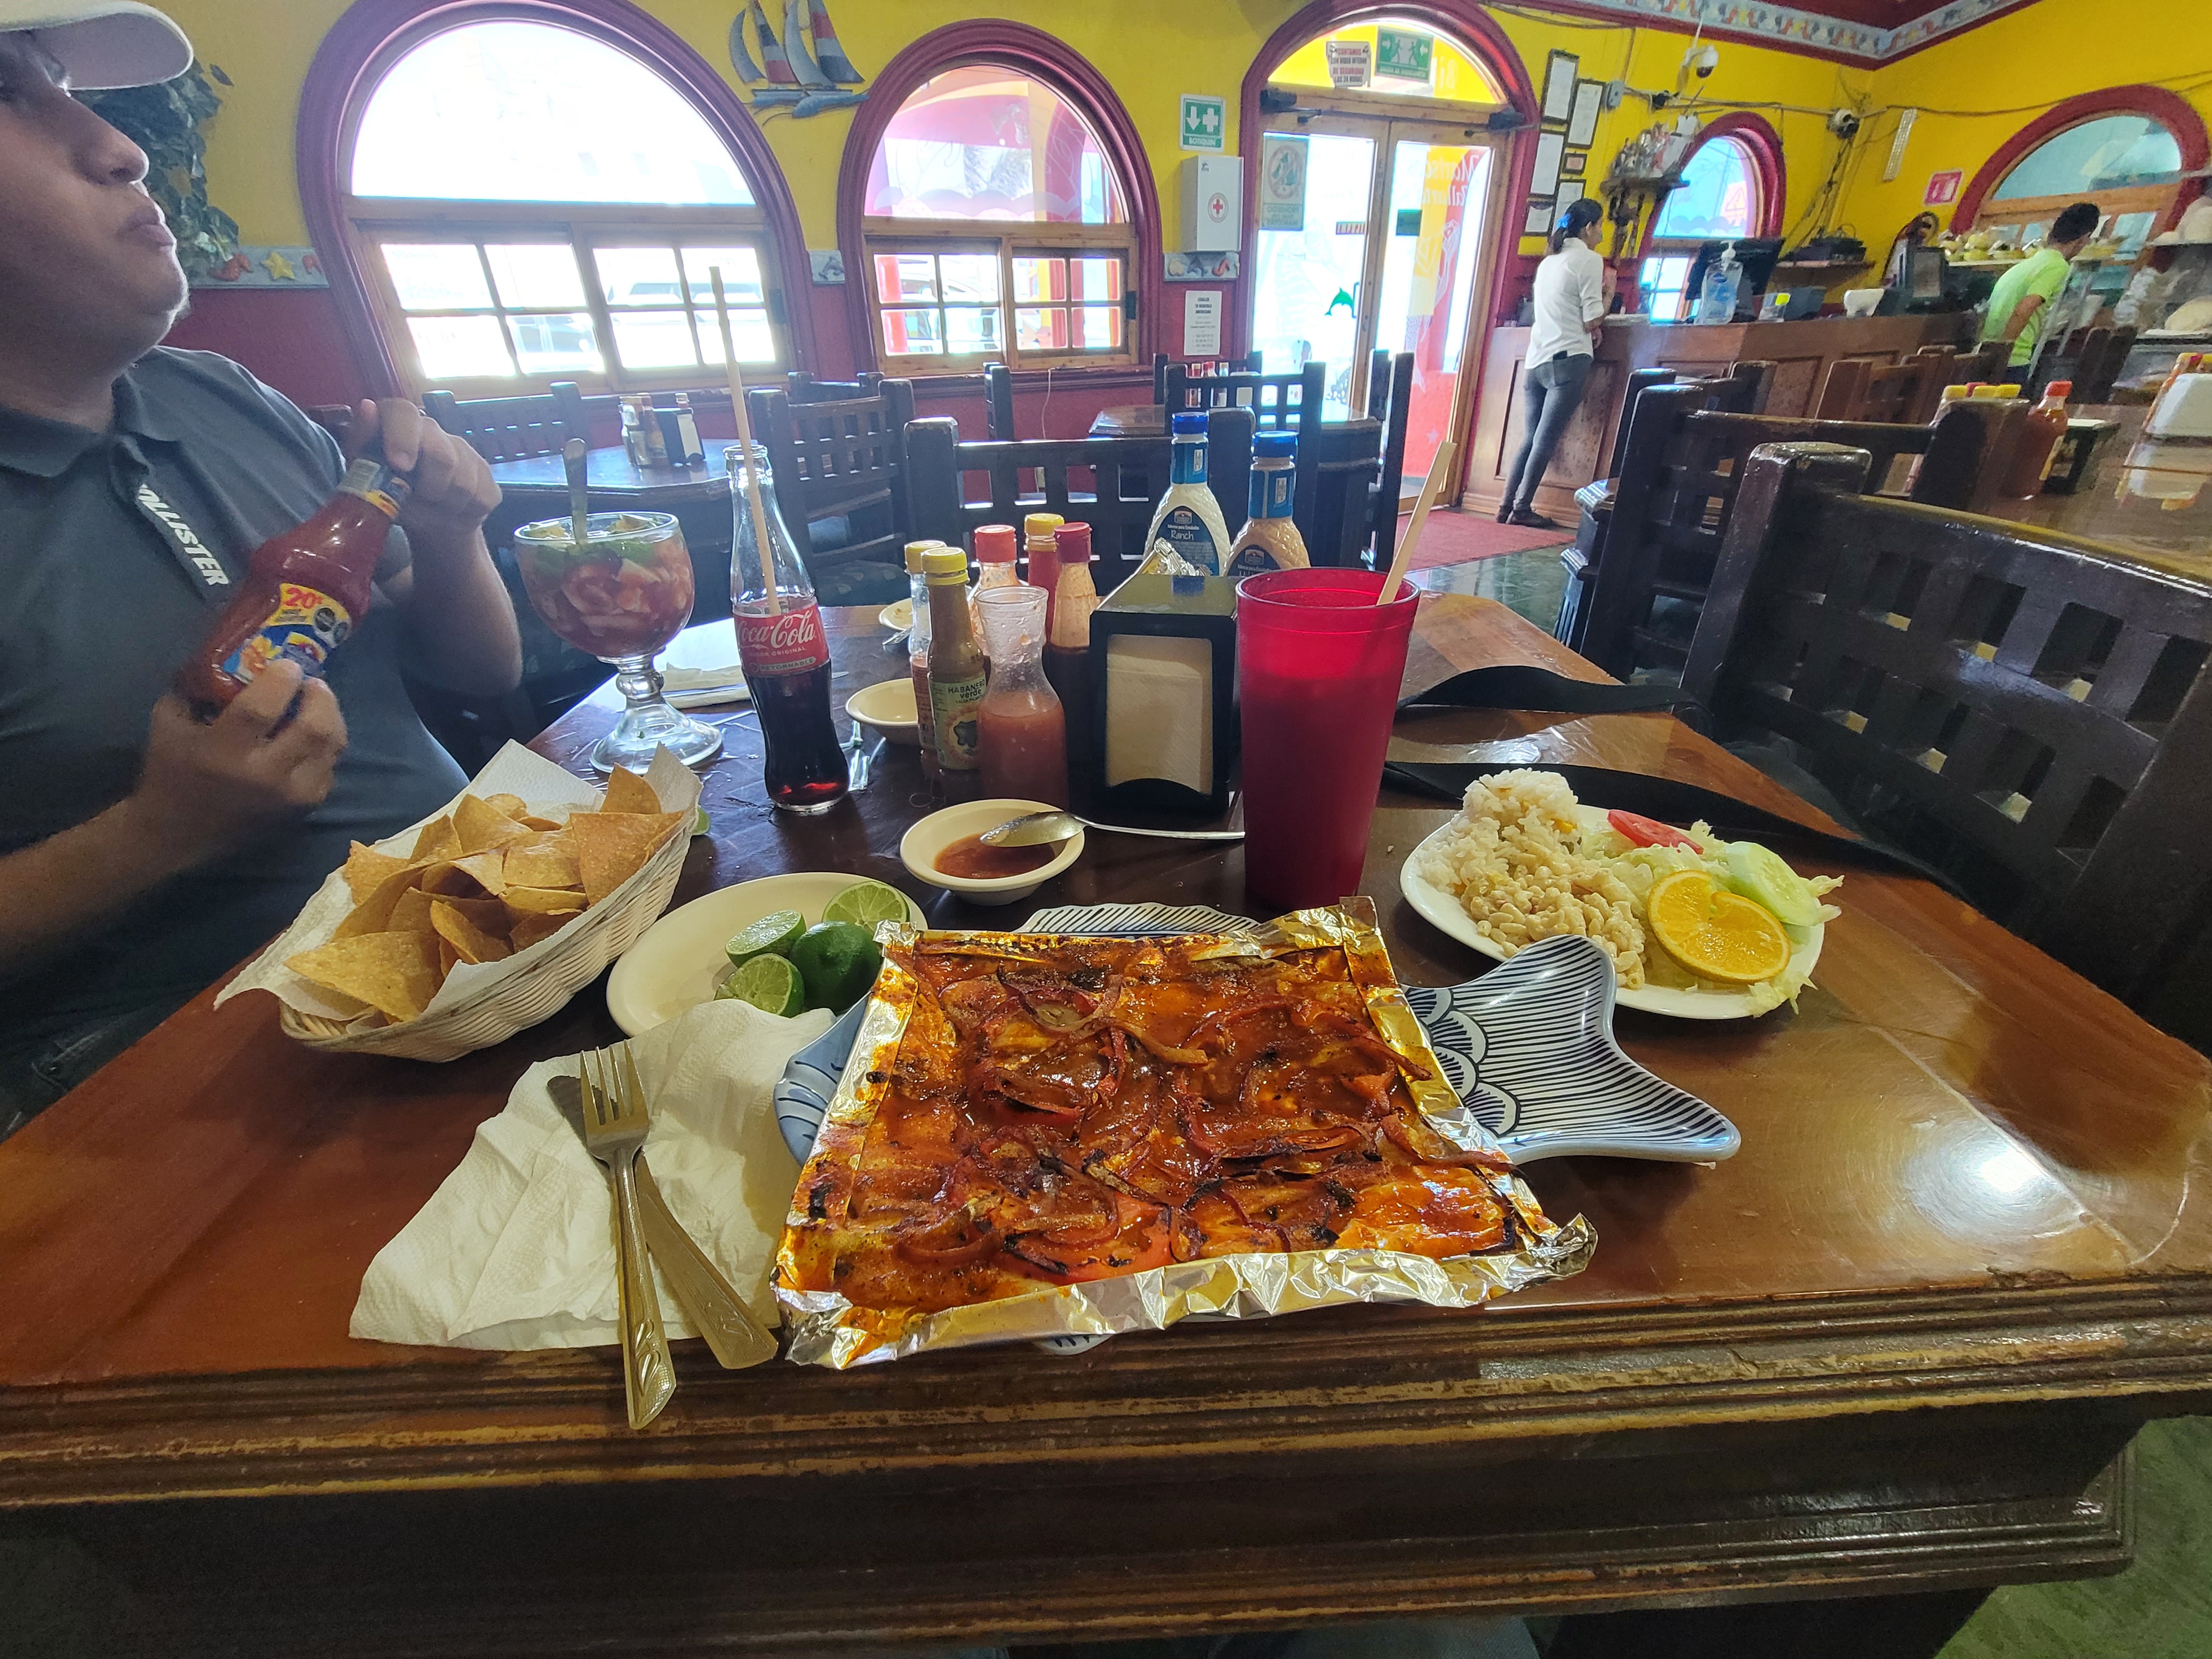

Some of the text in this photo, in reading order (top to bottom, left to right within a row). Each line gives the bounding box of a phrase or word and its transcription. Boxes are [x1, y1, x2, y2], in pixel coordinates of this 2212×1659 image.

[138, 483, 229, 586] OLLISTER
[1171, 529, 1194, 541] Ranch
[737, 609, 816, 649] Coca-Cola
[772, 646, 807, 656] ORIGINAL
[760, 658, 815, 671] RETORNABLE
[948, 679, 985, 694] HABANERO
[959, 688, 982, 699] verde
